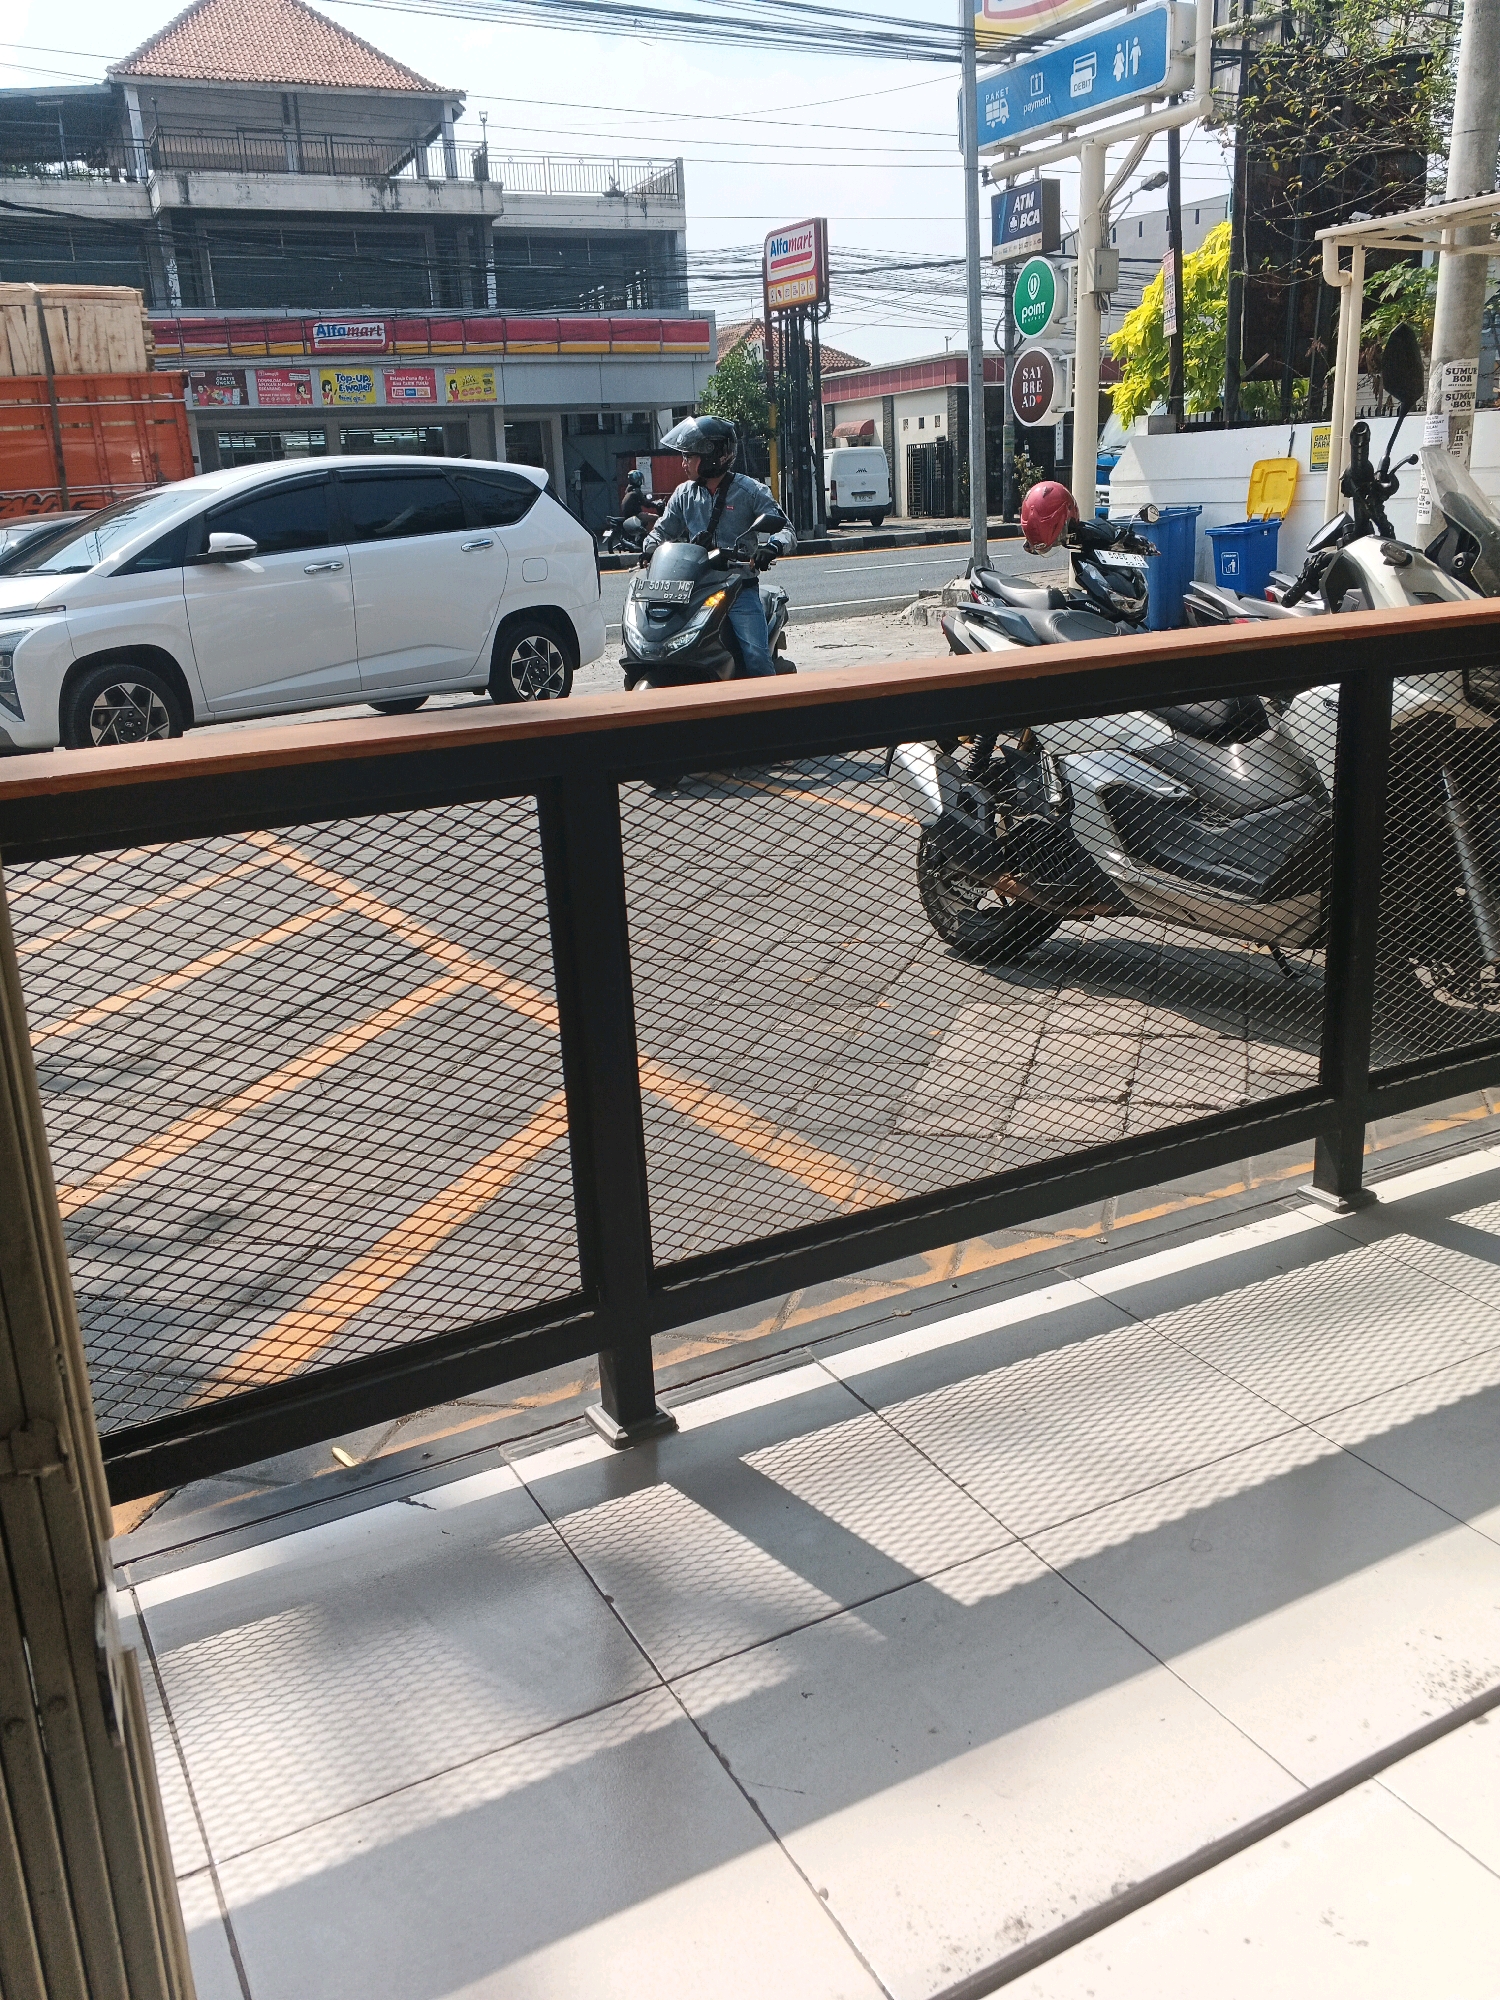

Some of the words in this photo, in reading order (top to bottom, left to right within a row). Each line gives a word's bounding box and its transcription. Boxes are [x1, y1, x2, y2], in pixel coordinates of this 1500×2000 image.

[1073, 78, 1093, 92] DEBIT
[985, 86, 1010, 101] PAKET
[1023, 94, 1052, 116] payment
[1013, 190, 1035, 213] ATM
[1020, 208, 1040, 229] BCA
[770, 230, 813, 258] Alfamart
[316, 323, 383, 338] Alfamart
[1022, 365, 1044, 380] SAY
[1452, 375, 1472, 383] BOR
[1022, 379, 1043, 395] BRE
[1022, 394, 1036, 408] AD
[637, 581, 645, 590] H
[649, 581, 671, 591] 5013
